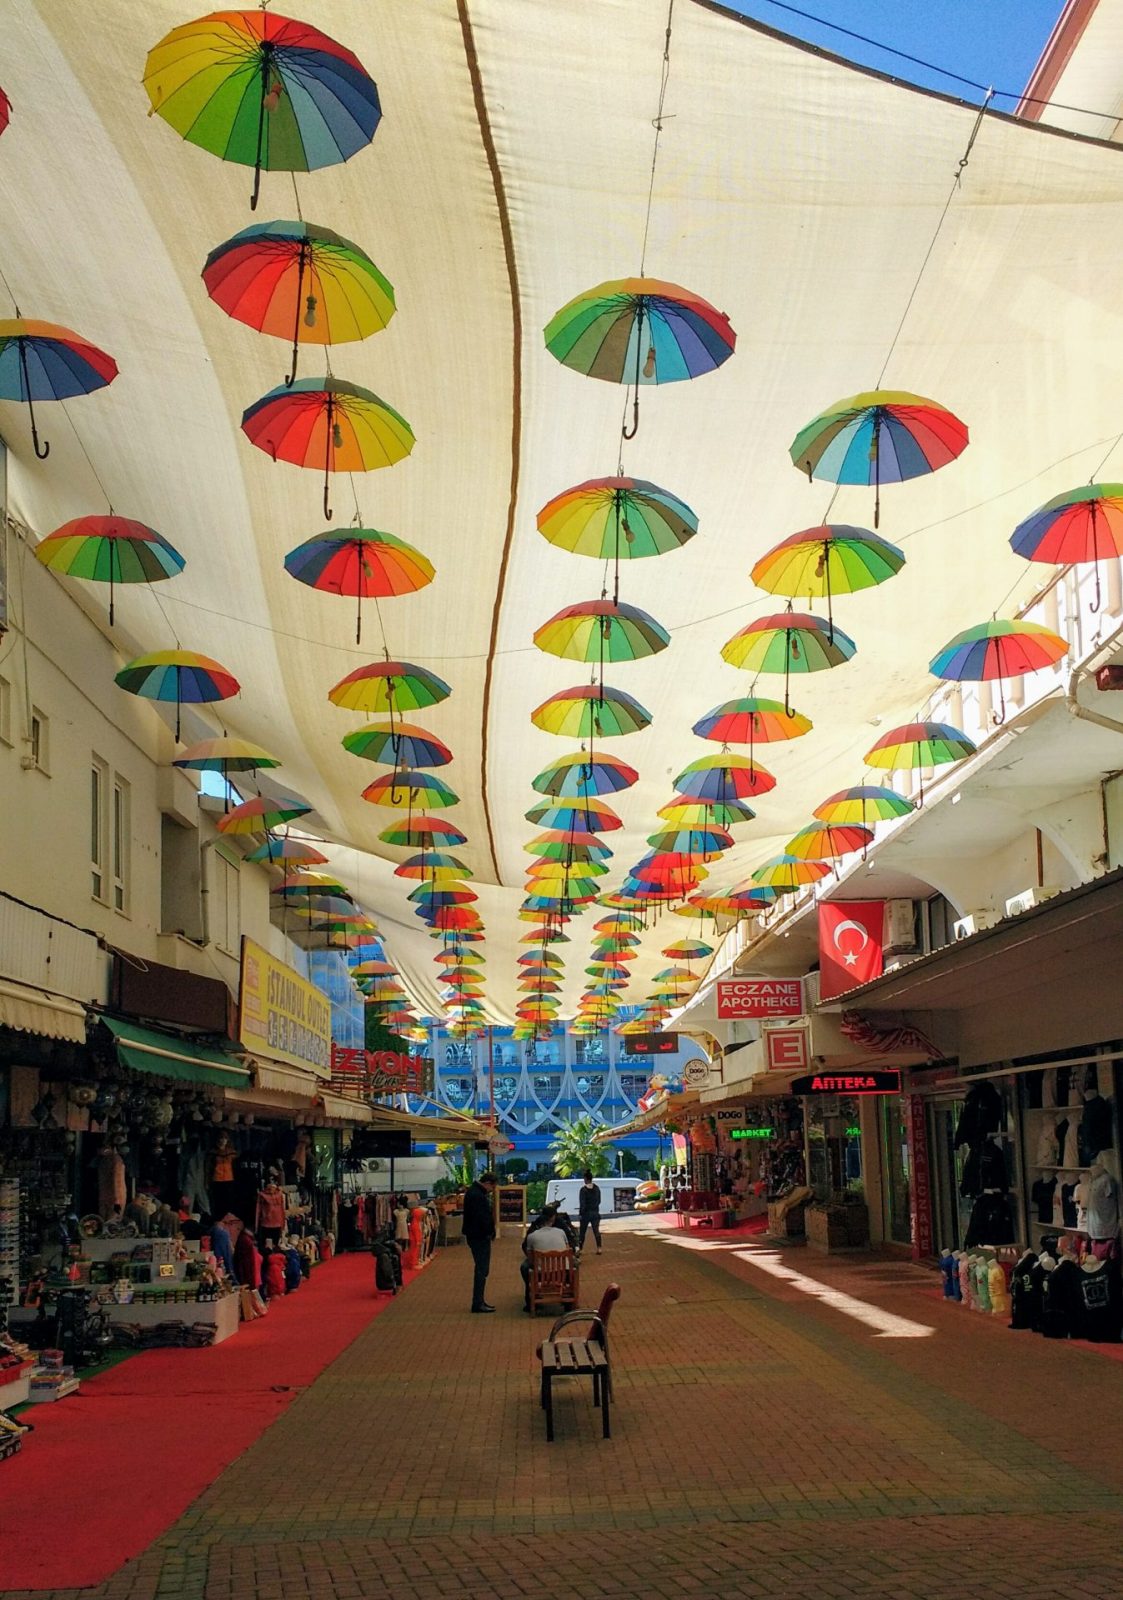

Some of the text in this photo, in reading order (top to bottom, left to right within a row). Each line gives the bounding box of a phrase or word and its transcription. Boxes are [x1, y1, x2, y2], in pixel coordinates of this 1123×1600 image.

[721, 984, 797, 995] ECZANE
[720, 996, 800, 1008] APOTHEKE
[772, 1035, 802, 1065] E
[330, 1042, 422, 1075] İZYON
[811, 1077, 877, 1090] АПТЕКА
[731, 1129, 772, 1138] MARKET
[912, 1094, 929, 1250] АПТЕКА ECZANE
